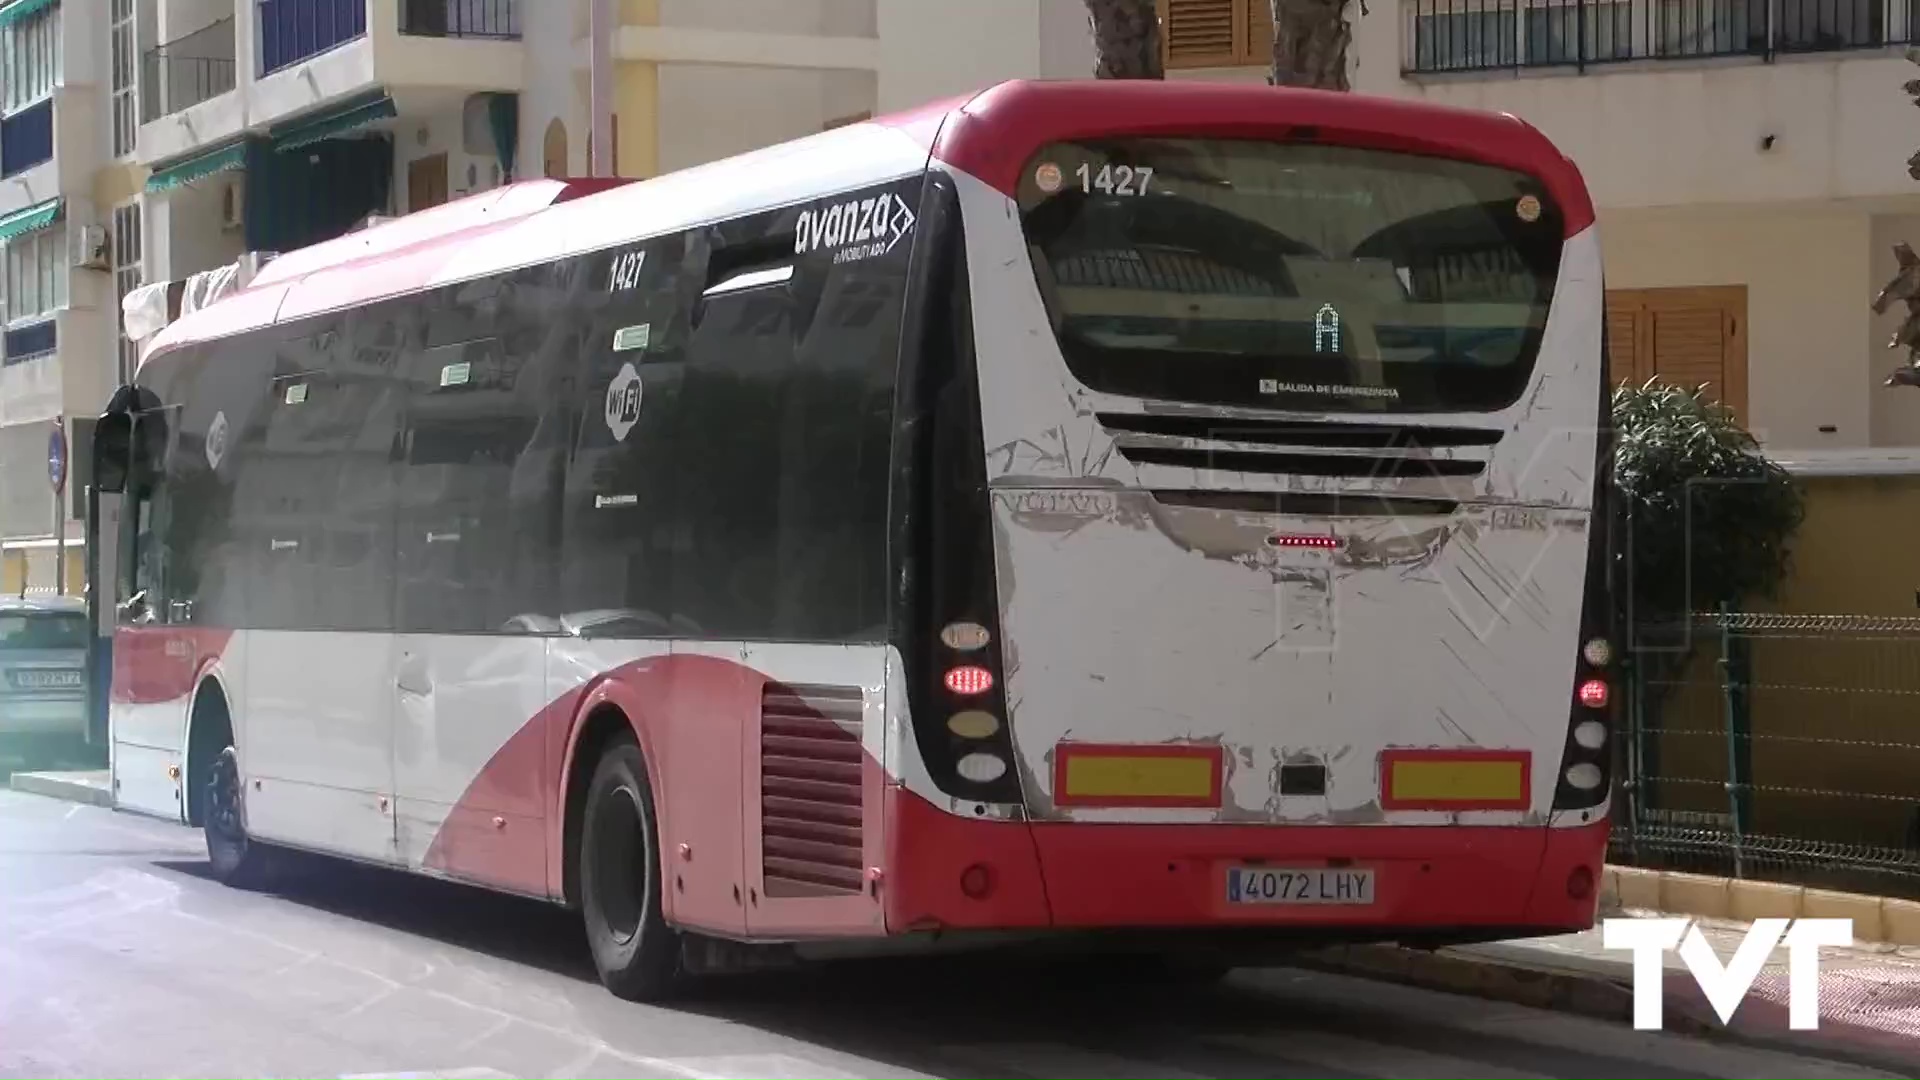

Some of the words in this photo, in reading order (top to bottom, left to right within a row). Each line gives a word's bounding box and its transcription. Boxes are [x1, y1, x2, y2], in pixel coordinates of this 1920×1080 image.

[1076, 162, 1153, 197] 1427
[794, 192, 892, 254] avanza
[610, 251, 646, 293] 1427
[1315, 303, 1339, 352] A
[1278, 382, 1315, 393] SALIDA
[1316, 384, 1331, 394] DE
[1245, 873, 1310, 899] 4072
[1319, 873, 1367, 898] LHY
